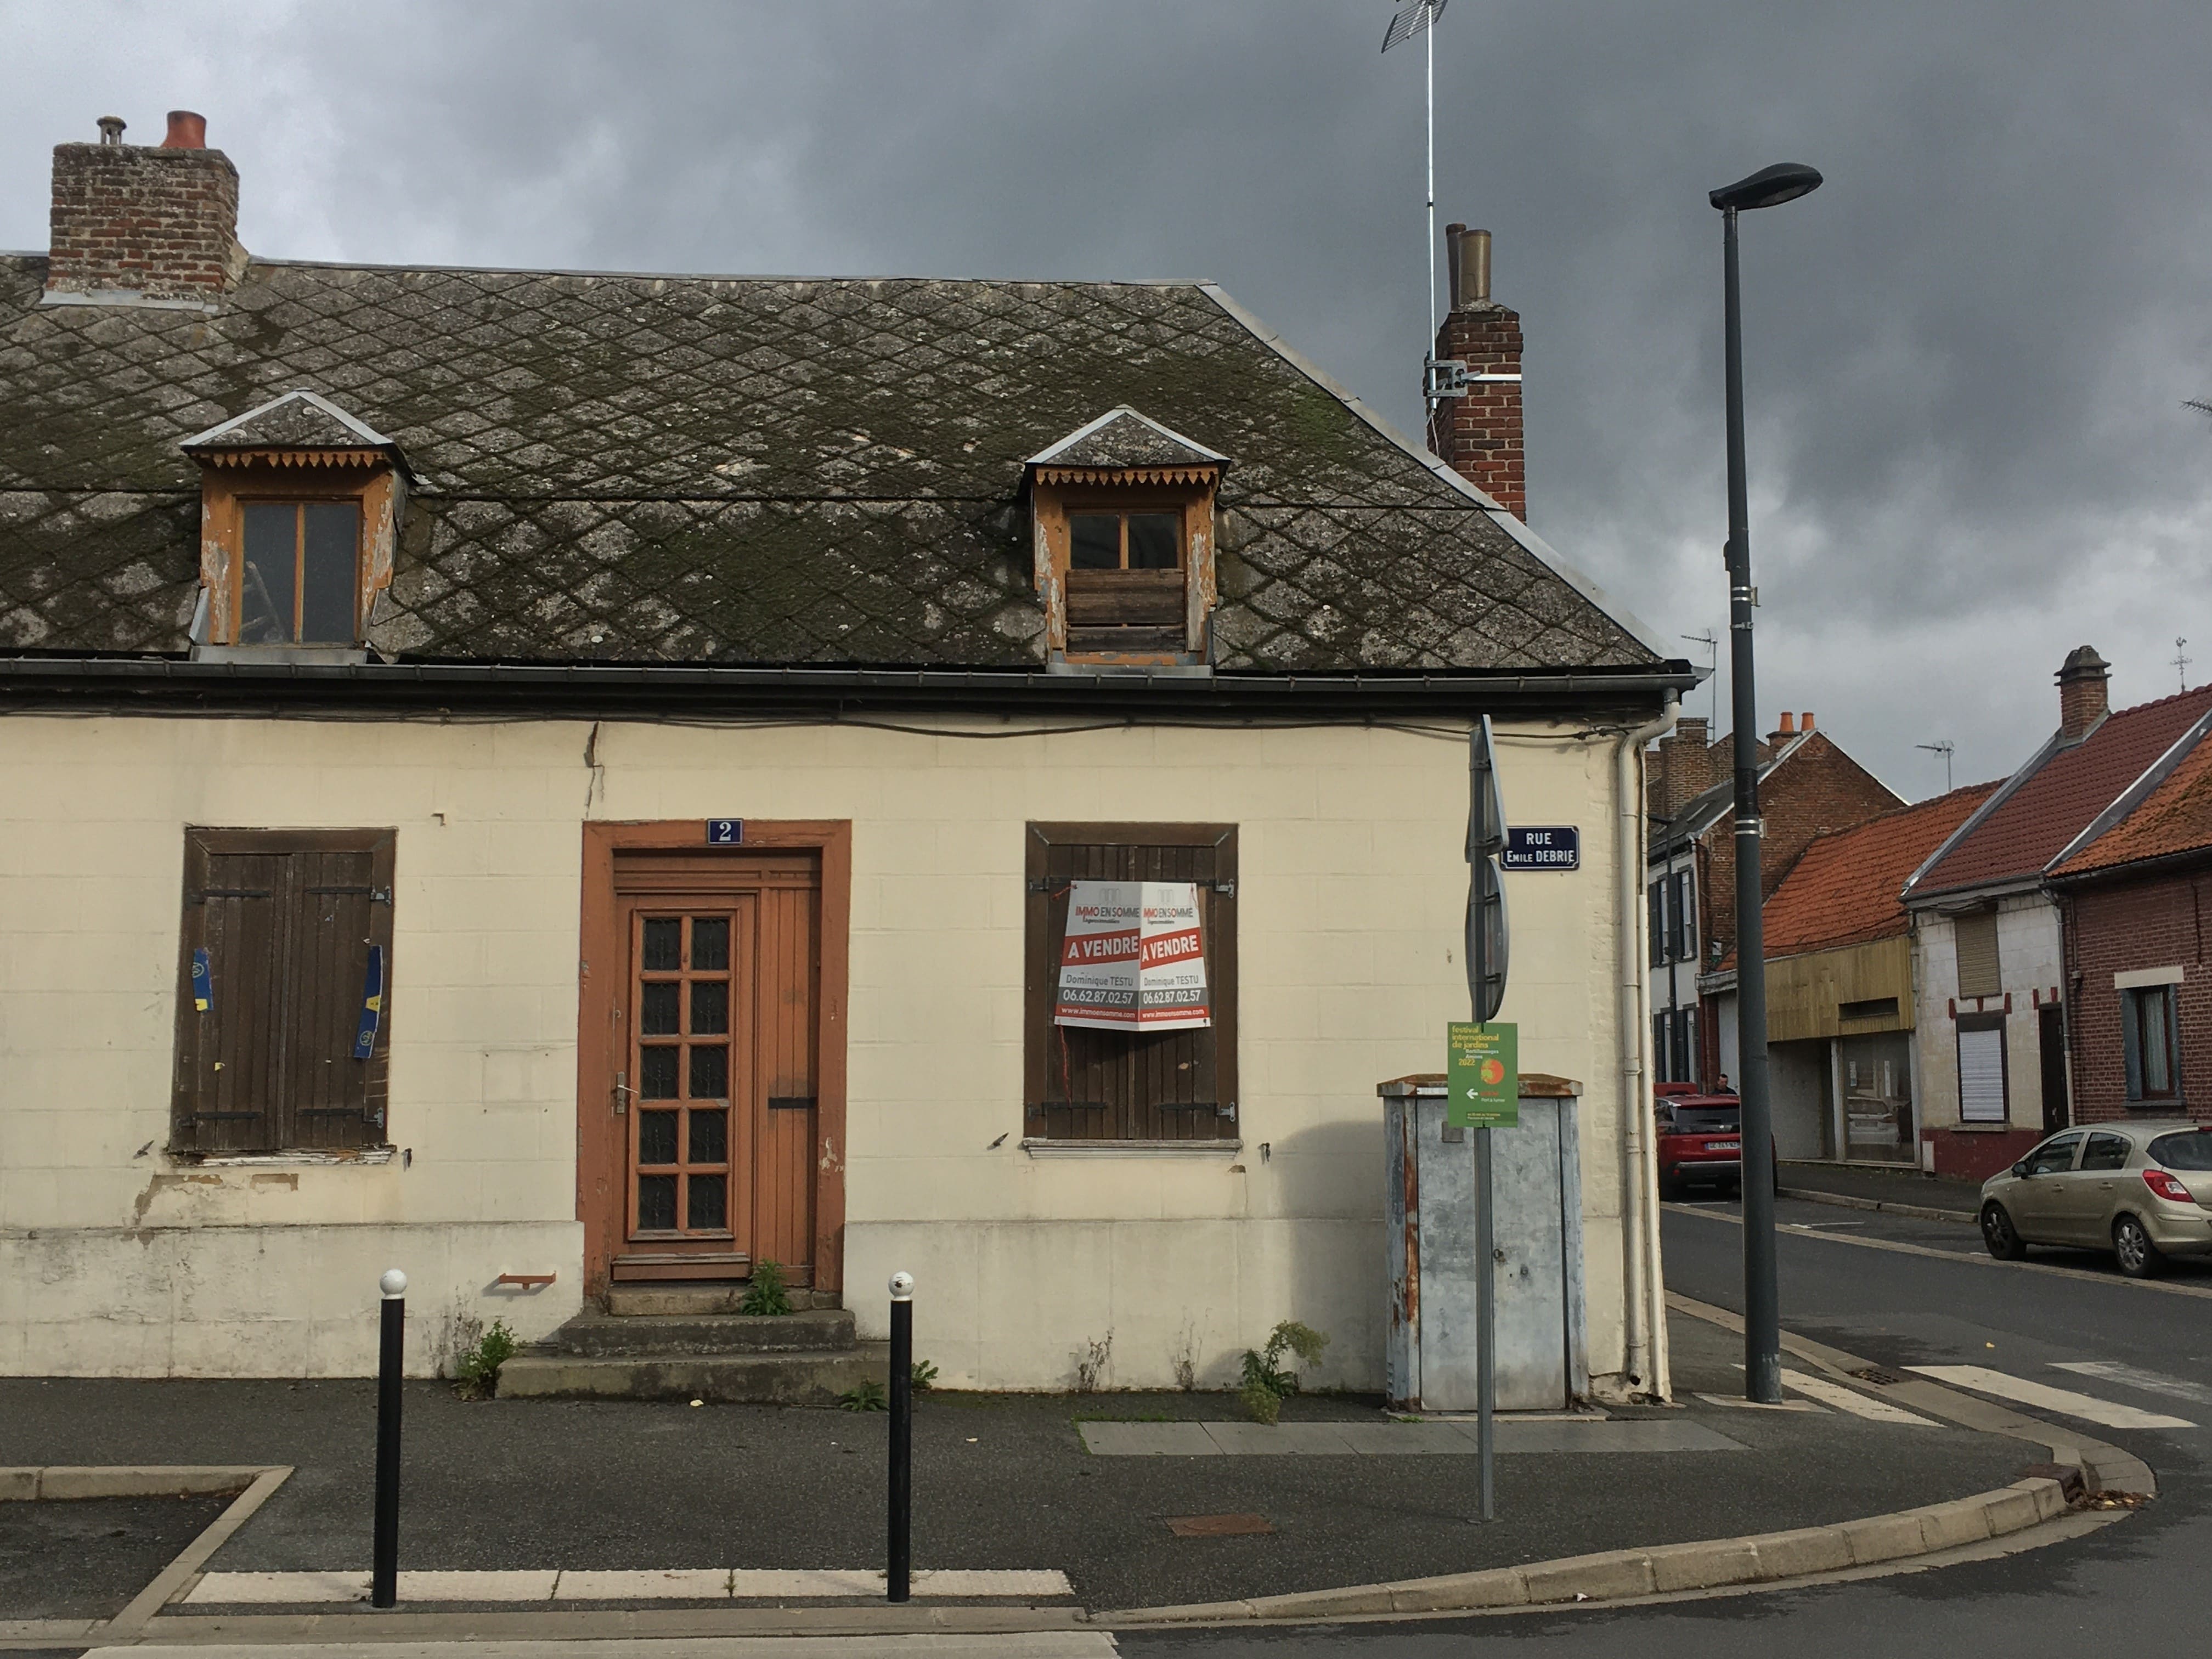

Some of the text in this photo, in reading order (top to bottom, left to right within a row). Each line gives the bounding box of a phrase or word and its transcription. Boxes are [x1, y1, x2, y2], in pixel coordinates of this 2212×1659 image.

[719, 822, 731, 841] 2
[1526, 833, 1552, 845] RUE
[1536, 850, 1575, 862] DEBRIE
[1068, 935, 1139, 958] A VENDRE
[1142, 934, 1199, 962] A VENDRE
[1066, 974, 1133, 986] Dominique TESTU
[1176, 975, 1199, 985] TESTU
[1063, 989, 1134, 1005] 06.62.87.02.57
[1143, 990, 1201, 1005] 06.62.87.02.57
[1463, 1041, 1488, 1049] jardins
